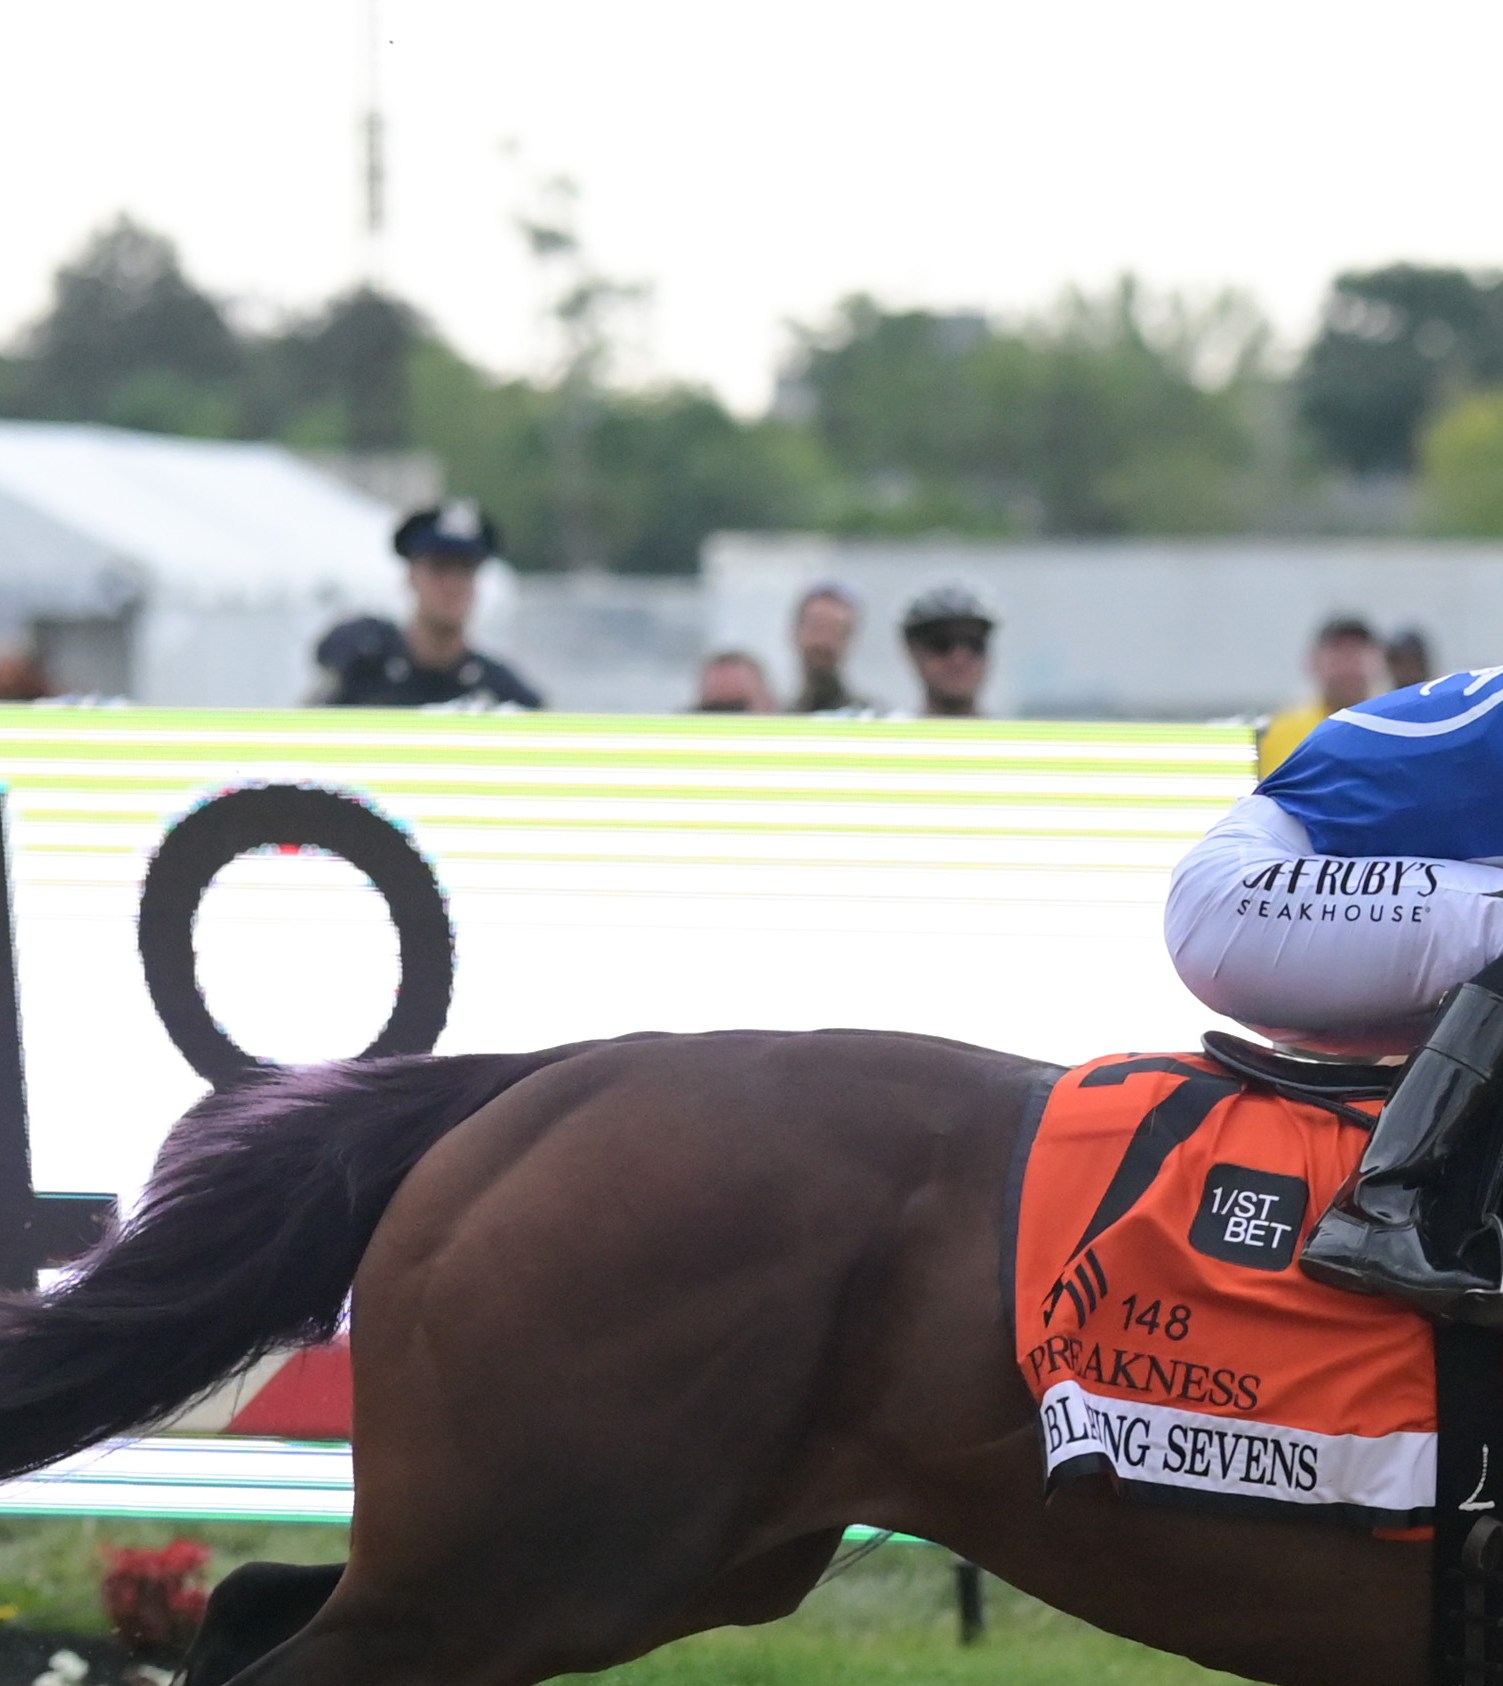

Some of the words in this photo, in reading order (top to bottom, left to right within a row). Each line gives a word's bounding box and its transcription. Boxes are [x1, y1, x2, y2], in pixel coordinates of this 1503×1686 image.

[1315, 859, 1446, 898] RUBY'S
[1211, 1186, 1280, 1221] 1/ST
[1223, 1216, 1292, 1249] BET
[1121, 1295, 1192, 1341] 148
[1027, 1335, 1262, 1411] PREAKNESS
[1162, 1423, 1319, 1492] SEVENS
